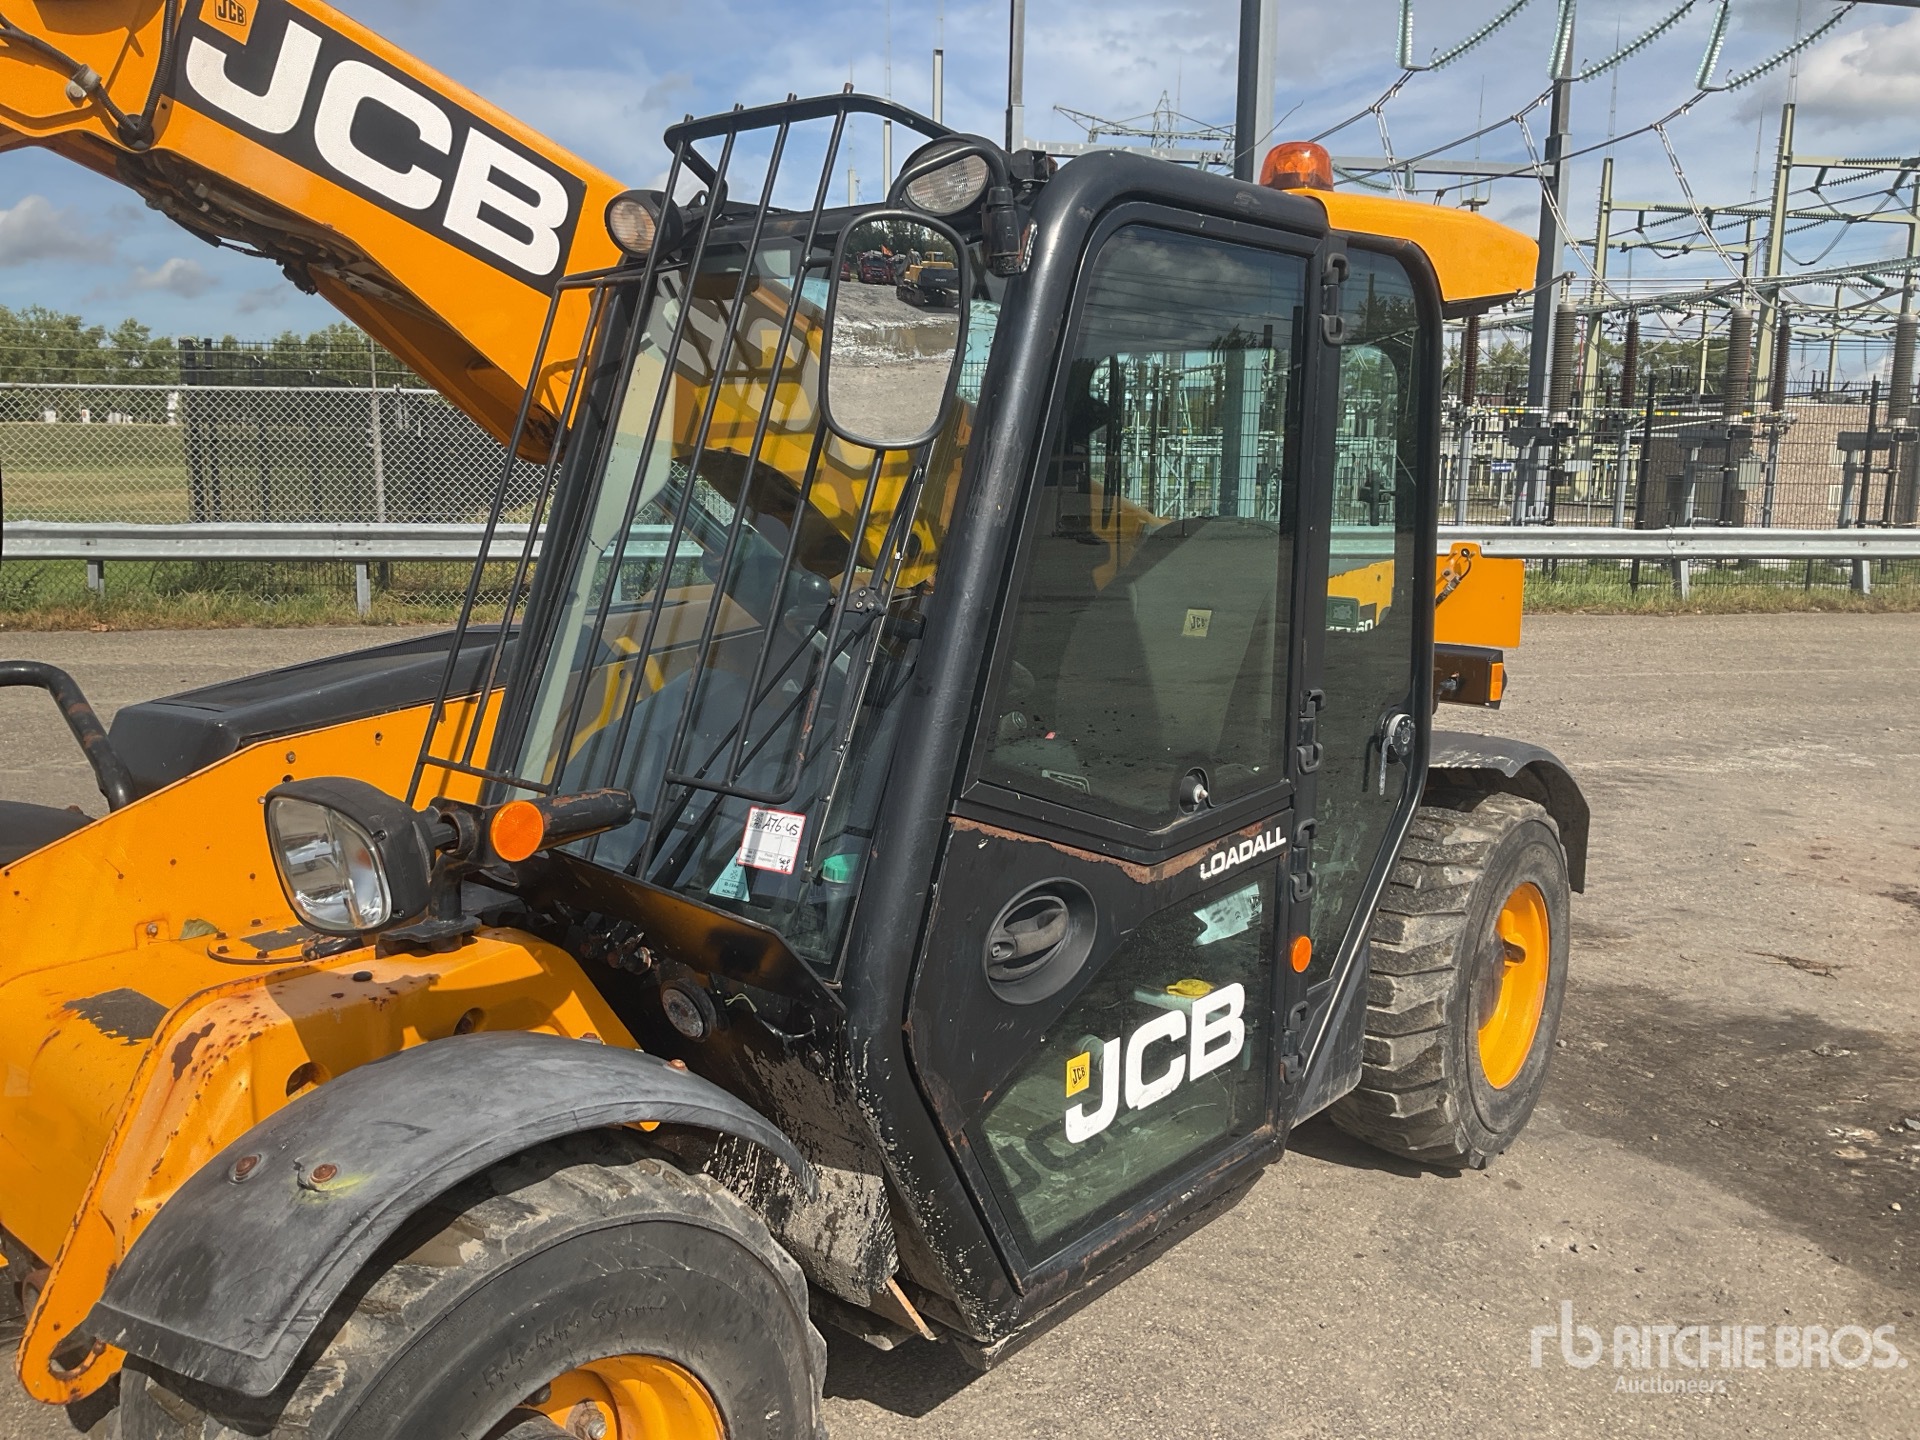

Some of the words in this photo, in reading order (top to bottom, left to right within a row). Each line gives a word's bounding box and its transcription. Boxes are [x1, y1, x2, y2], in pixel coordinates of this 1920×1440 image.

[217, 0, 244, 24] JCB
[186, 20, 569, 276] JCB
[1200, 827, 1287, 880] LOADALL
[1065, 982, 1245, 1144] JCB
[1072, 1067, 1086, 1085] JCB
